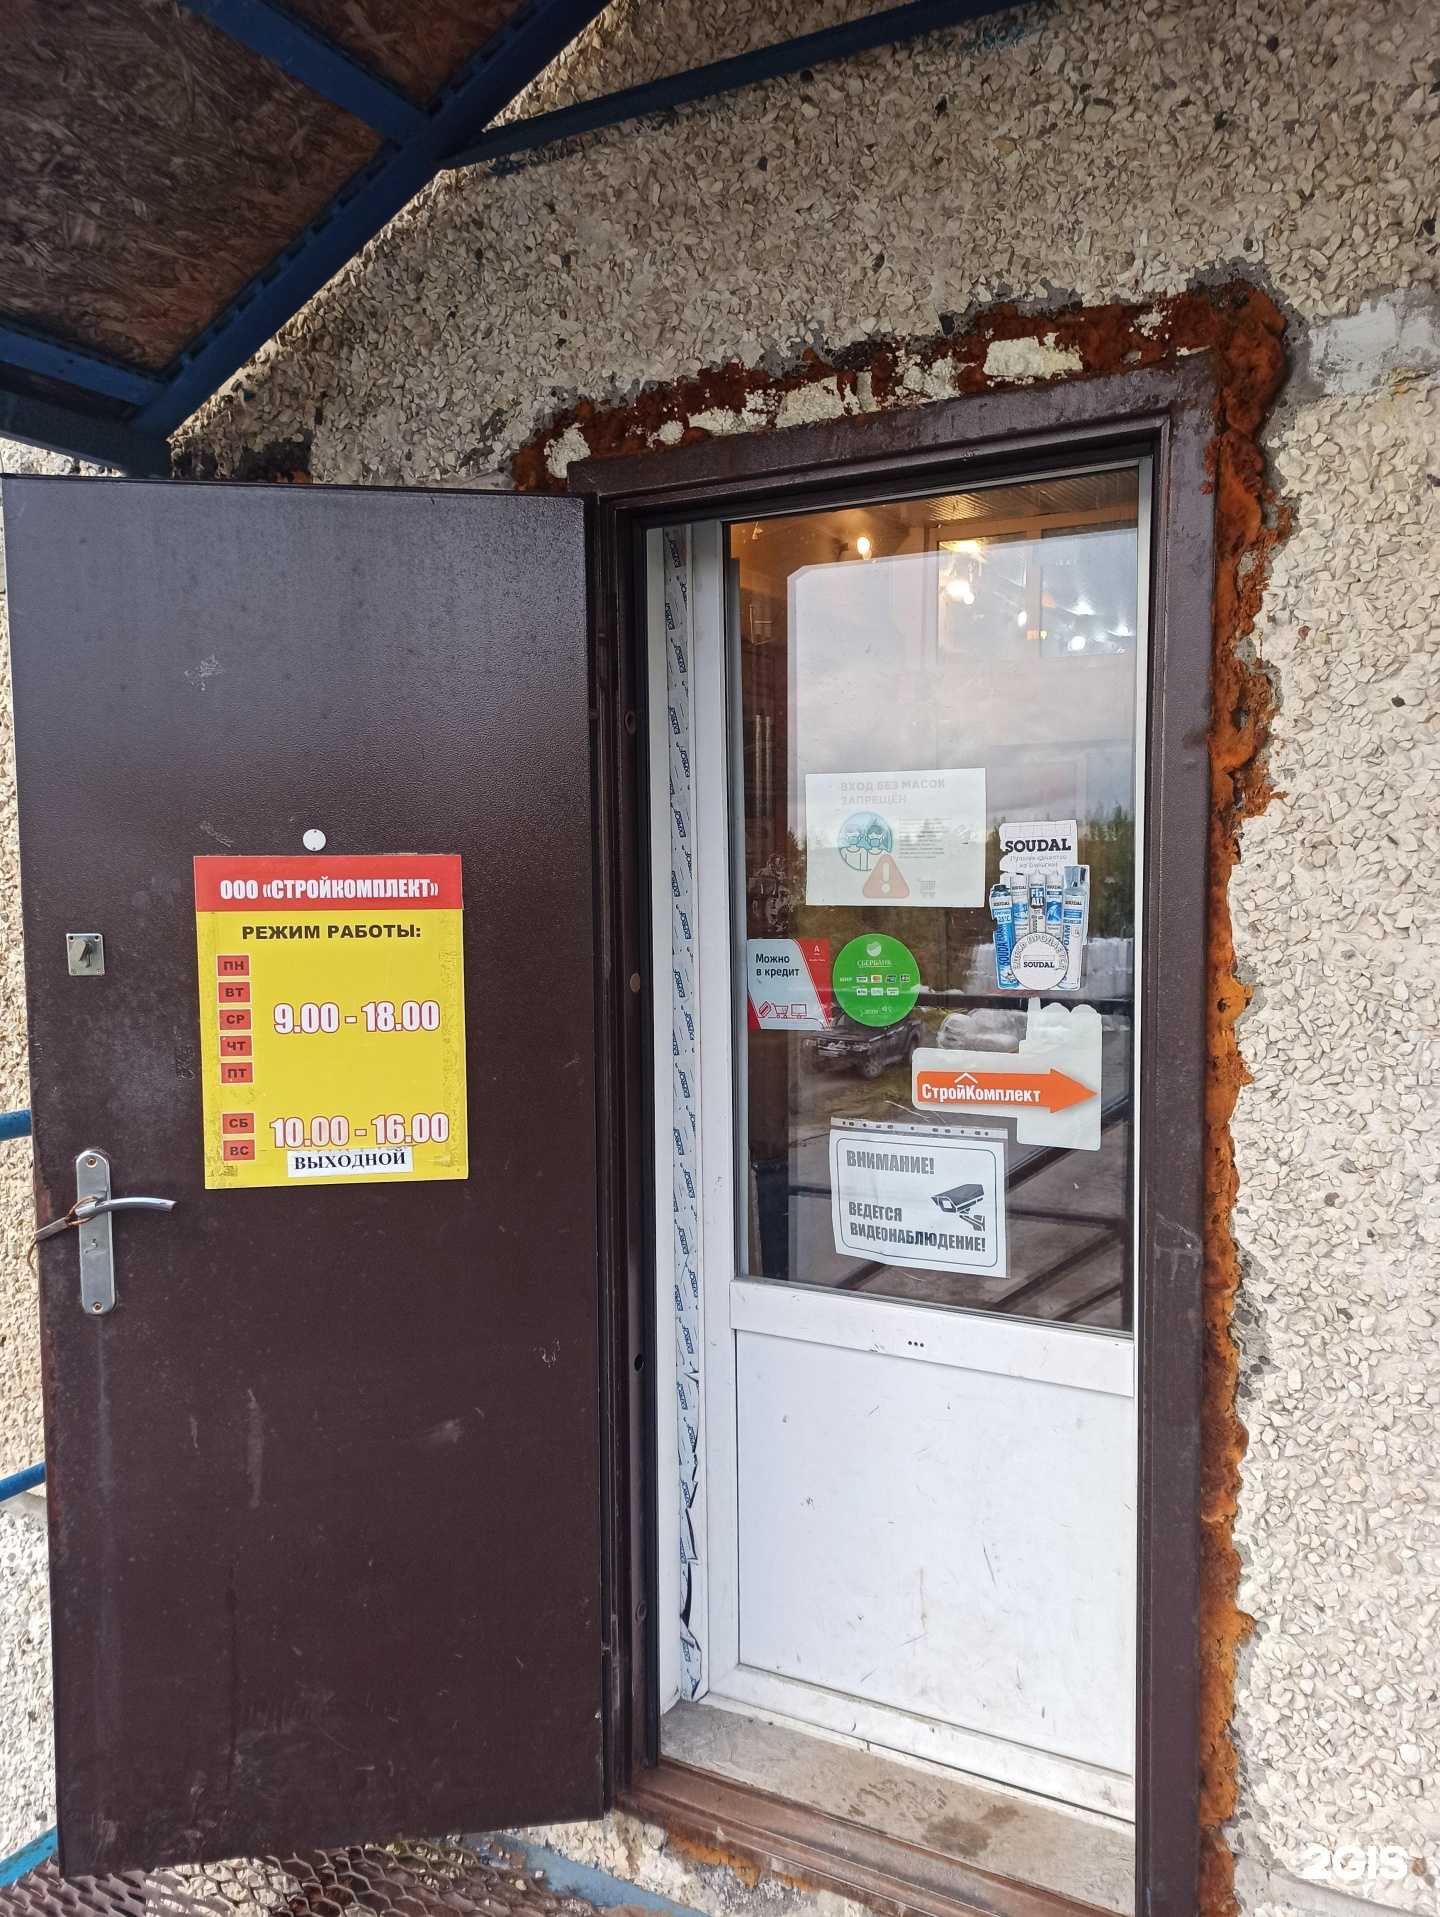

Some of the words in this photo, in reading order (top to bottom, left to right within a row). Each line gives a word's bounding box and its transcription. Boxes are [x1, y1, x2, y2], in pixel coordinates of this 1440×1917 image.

[840, 780, 873, 793] ВХОД
[876, 780, 898, 792] БЕЗ
[1005, 838, 1071, 853] SOUDAL
[220, 879, 259, 900] ООО
[263, 875, 440, 900] «СТРОЙКОМПЛЕКТ»
[672, 871, 681, 897] EXPR
[241, 924, 320, 941] РЕЖИМ
[327, 923, 422, 940] РАБОТЫ:
[755, 953, 790, 964] Можно
[1023, 961, 1055, 969] SOUDAL
[223, 960, 245, 972] ПН
[756, 968, 762, 976] в
[764, 967, 800, 978] кредит
[224, 987, 245, 999] ВТ
[225, 1013, 246, 1025] СР
[272, 1002, 341, 1035] 9.00
[361, 999, 441, 1033] 18.00
[226, 1040, 247, 1052] ЧТ
[227, 1067, 248, 1080] ПТ
[921, 1082, 1041, 1103] СтройКомплект
[228, 1118, 250, 1130] СБ
[268, 1114, 350, 1149] 10.00
[370, 1112, 451, 1146] 16.00
[229, 1145, 250, 1157] ВС
[294, 1151, 407, 1172] ВЫХОДНОЙ
[846, 1149, 936, 1175] ВНИМАНИЕ!
[848, 1200, 903, 1223] ВЕДЕТСЯ
[850, 1221, 987, 1253] ВИДЕОНАБЛЮДЕНИЕ!
